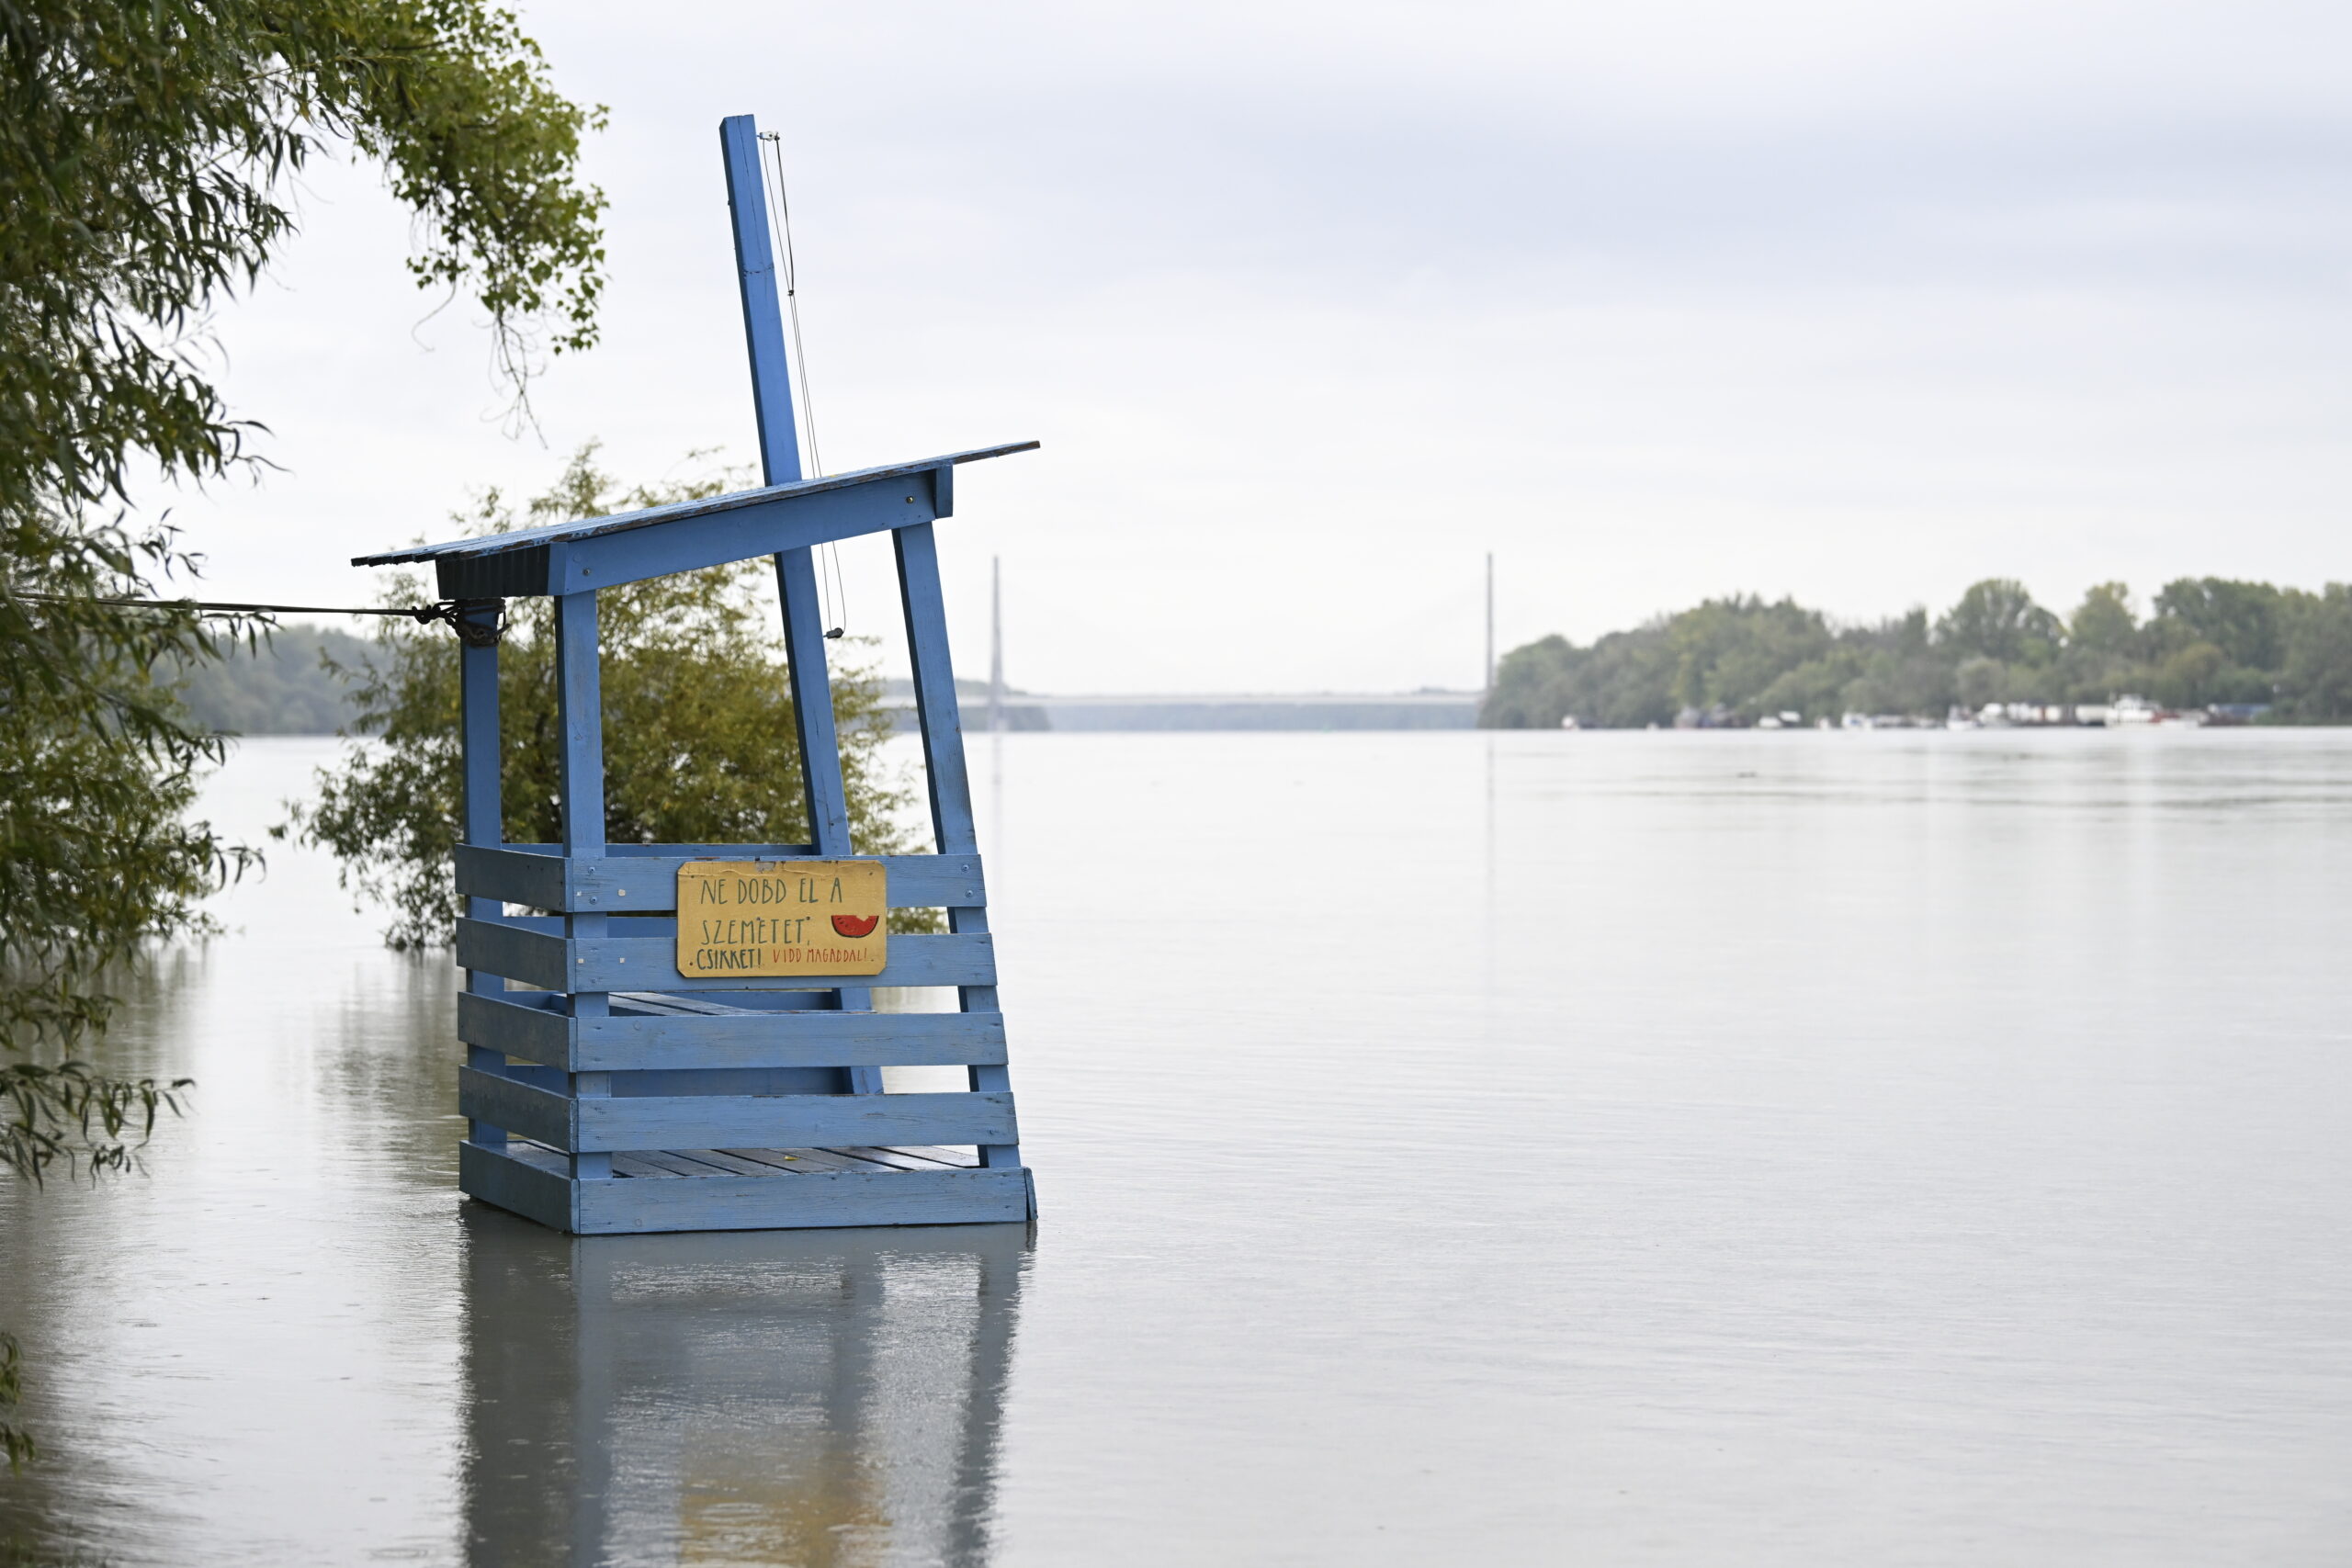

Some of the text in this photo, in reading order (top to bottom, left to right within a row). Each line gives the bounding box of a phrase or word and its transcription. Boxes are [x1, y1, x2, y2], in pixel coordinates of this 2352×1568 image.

[700, 877, 842, 905] NE DOBD EL A
[696, 947, 867, 970] CSIKKET! VIDD MAGADDAL!
